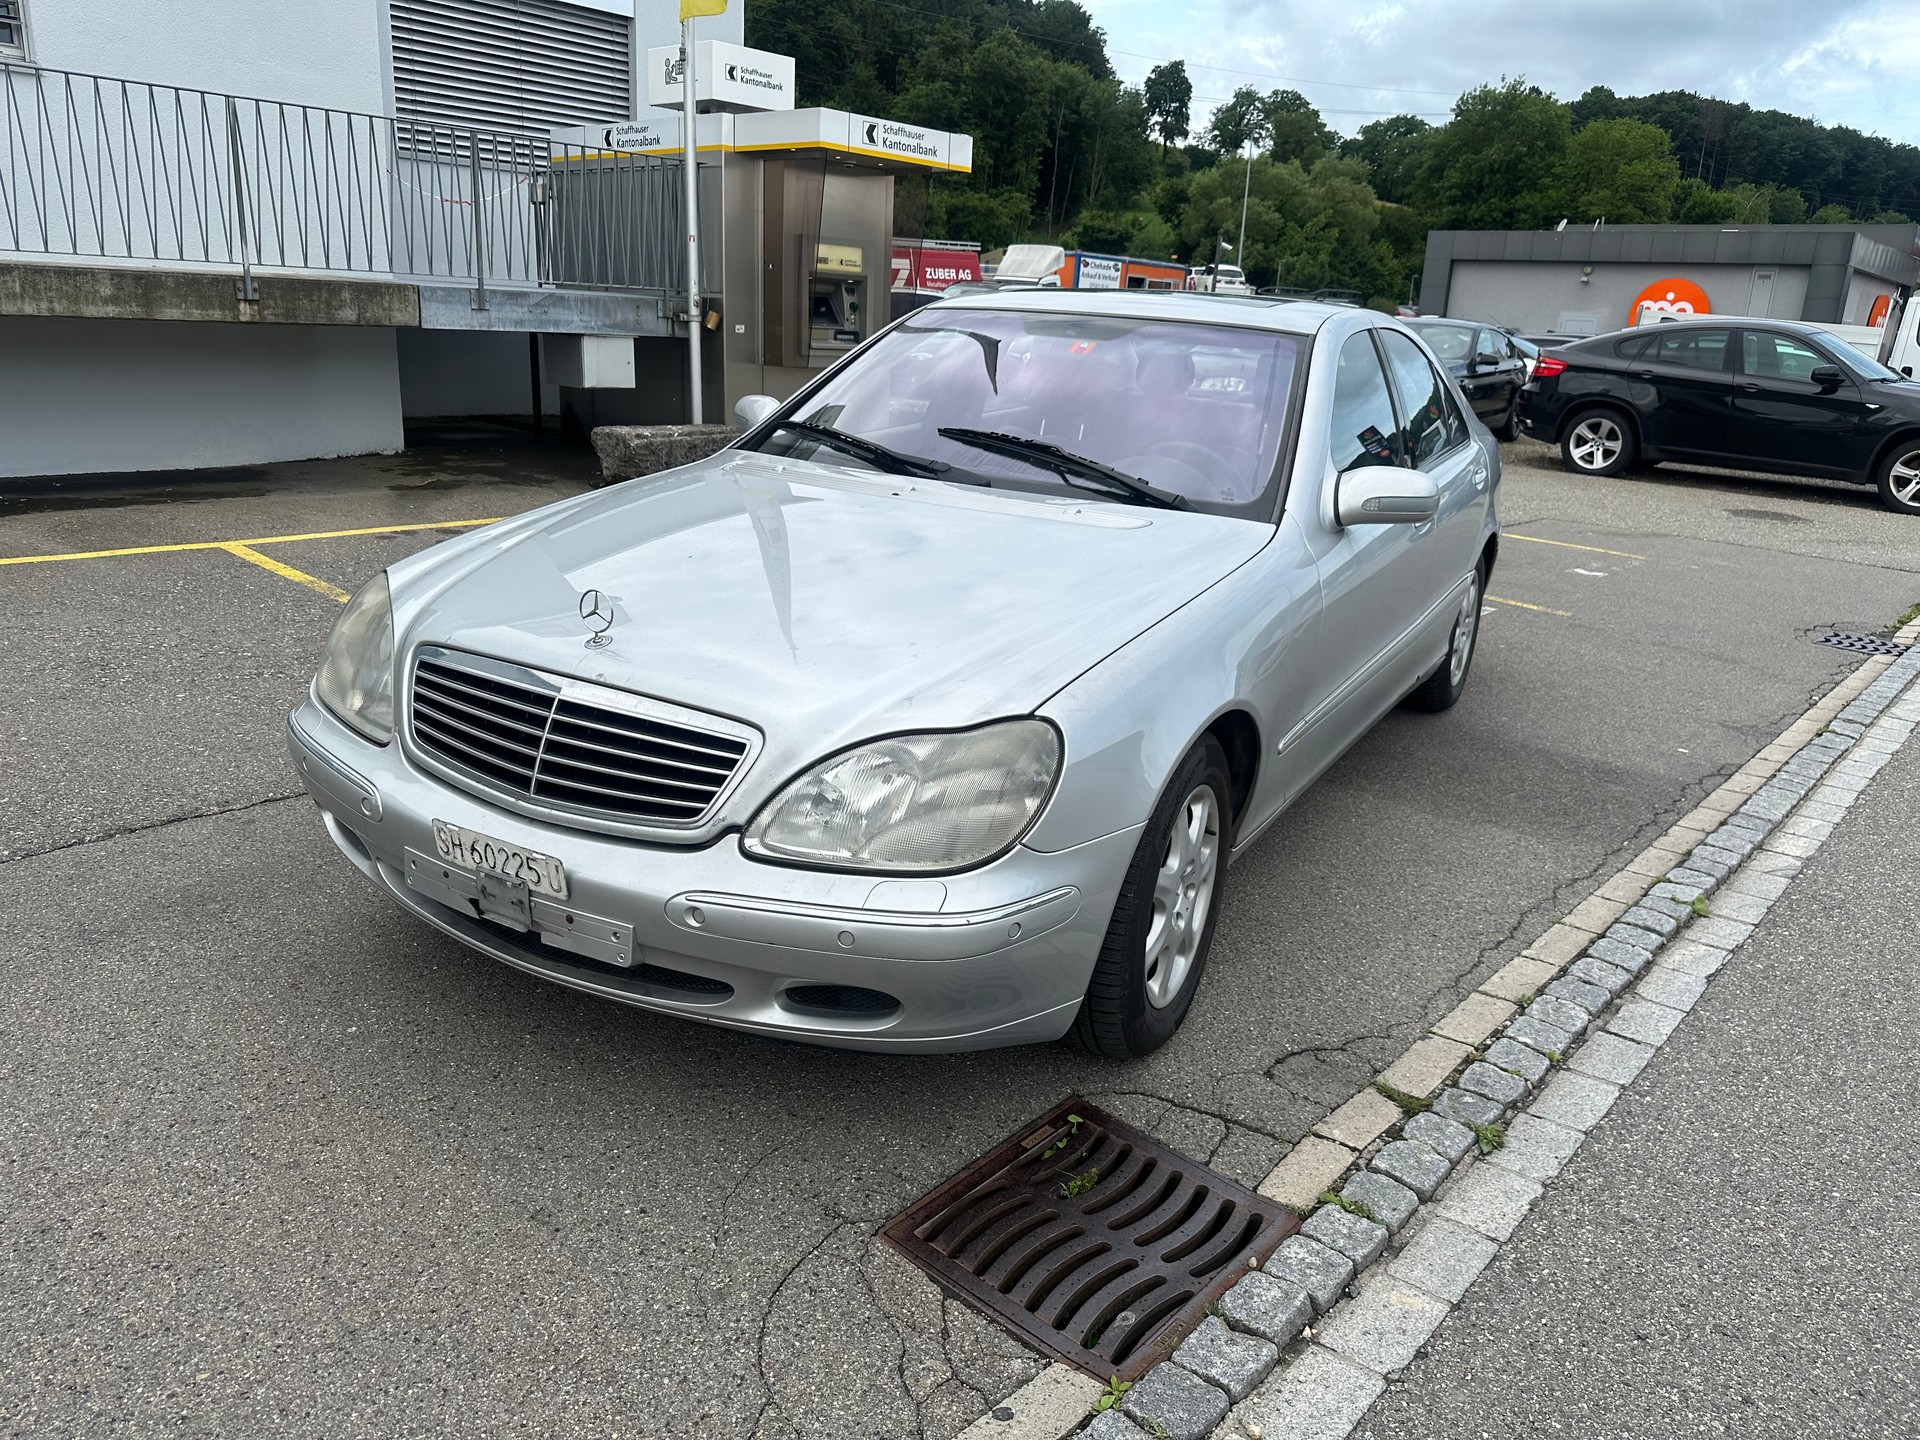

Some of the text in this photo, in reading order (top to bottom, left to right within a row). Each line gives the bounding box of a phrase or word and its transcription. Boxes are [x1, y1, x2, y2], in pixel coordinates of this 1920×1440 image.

[740, 66, 773, 79] Schaffhauser
[740, 75, 784, 91] Kantonalbank
[616, 125, 649, 135] Schaffhauser
[882, 124, 925, 140] Schaffhauser
[616, 134, 661, 148] Kantonalbank
[882, 137, 938, 157] Kantonalbank
[925, 267, 972, 280] ZUBER AG
[470, 839, 541, 887] 60225
